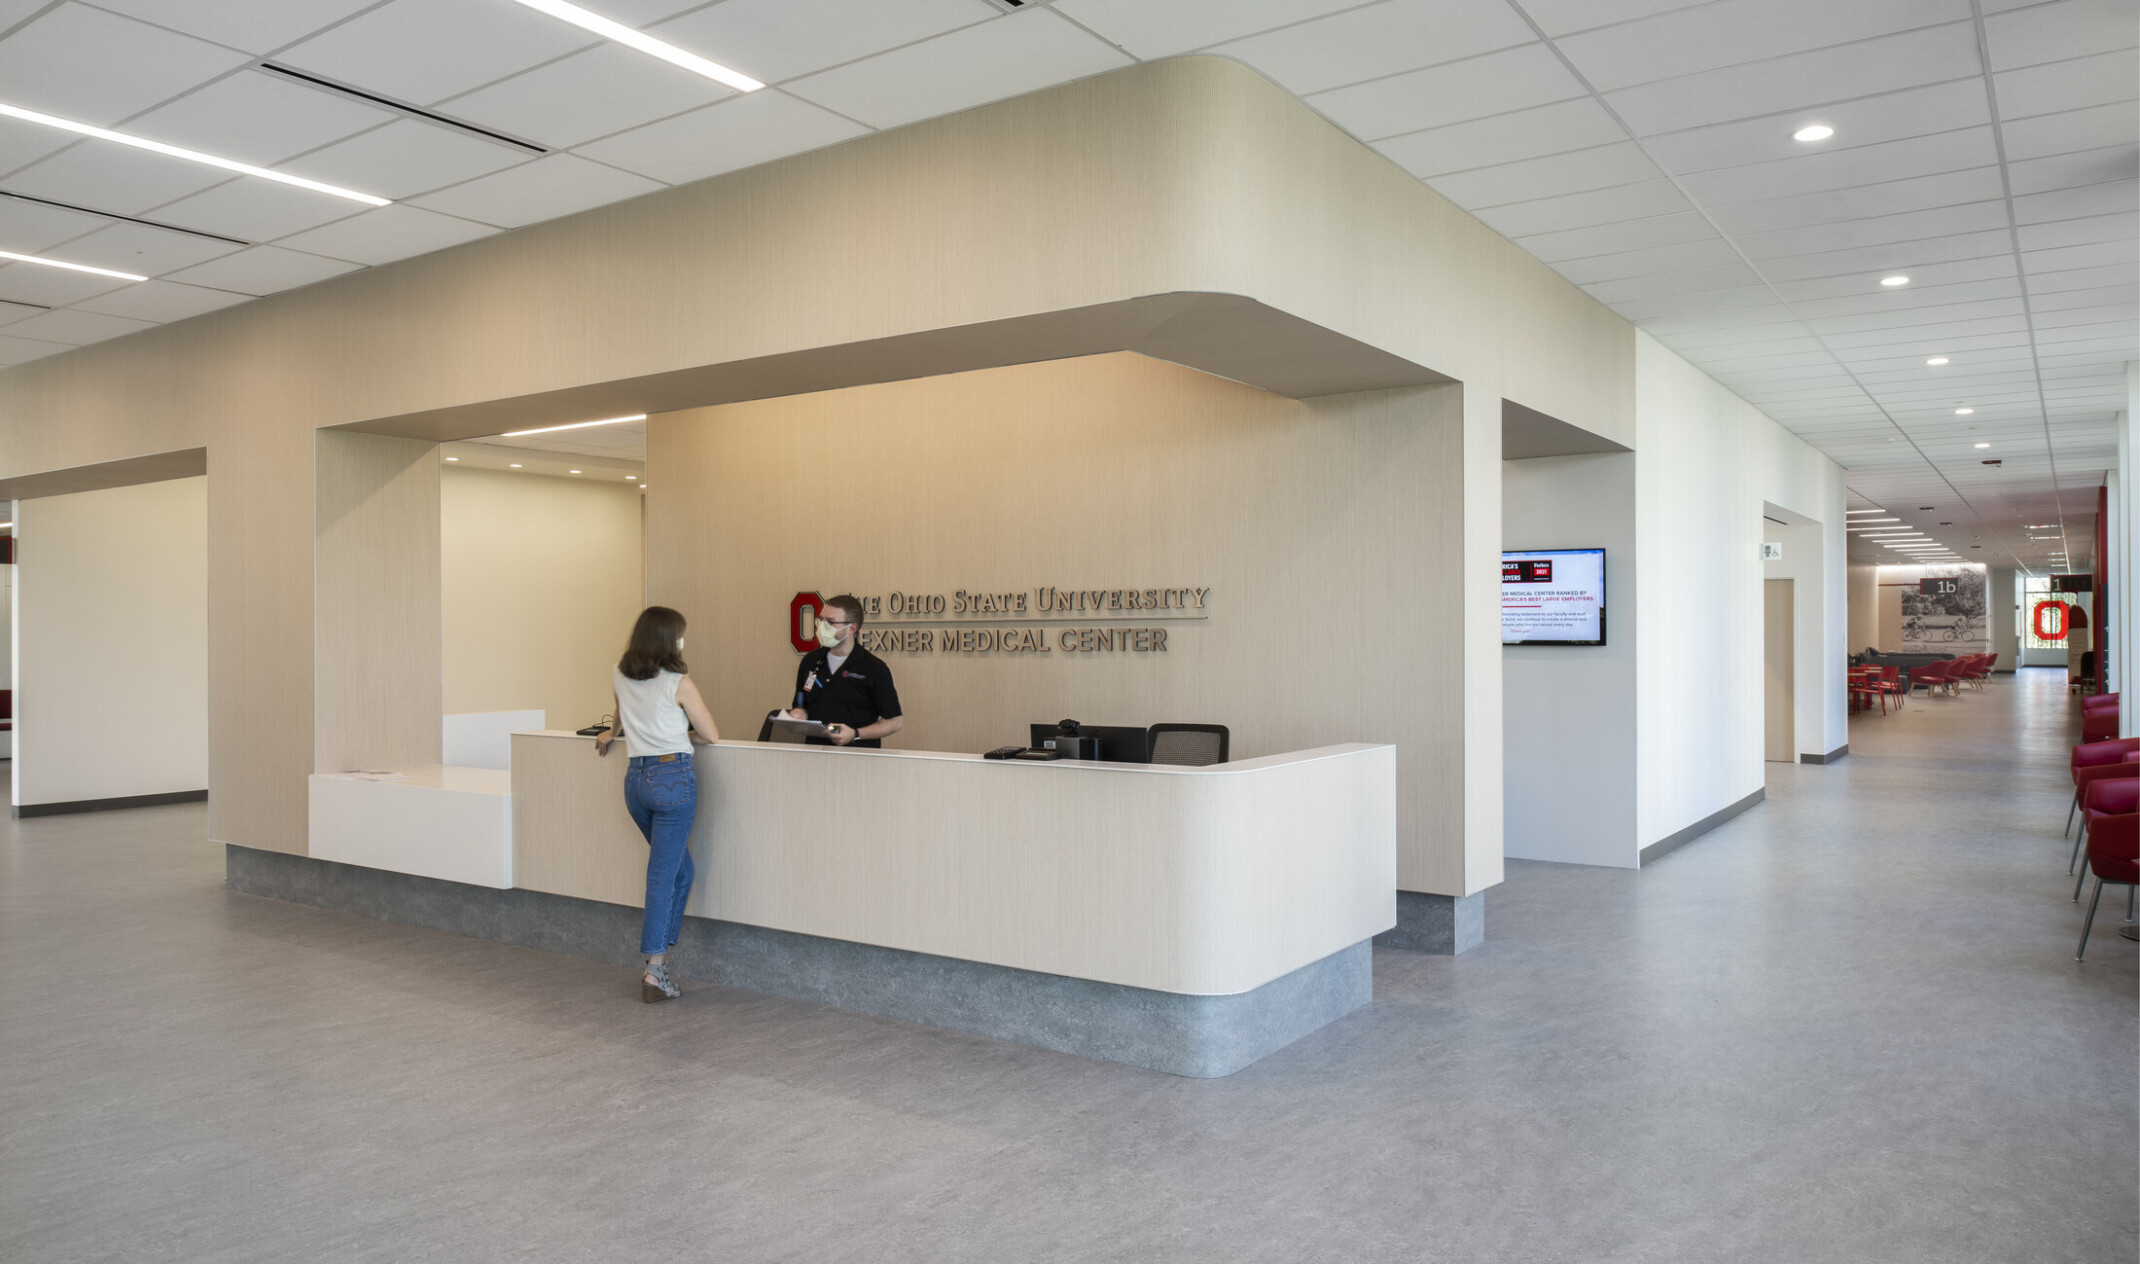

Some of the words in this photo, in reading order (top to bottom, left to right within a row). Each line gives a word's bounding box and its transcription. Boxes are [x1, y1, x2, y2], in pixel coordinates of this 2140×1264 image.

[1937, 581, 1957, 593] 1b
[888, 591, 946, 615] OHIO
[952, 589, 1027, 613] STATE
[1033, 586, 1210, 611] UNIVERSITY
[855, 629, 934, 652] EXNER
[940, 628, 1051, 653] MEDICAL
[1057, 628, 1168, 652] CENTER
